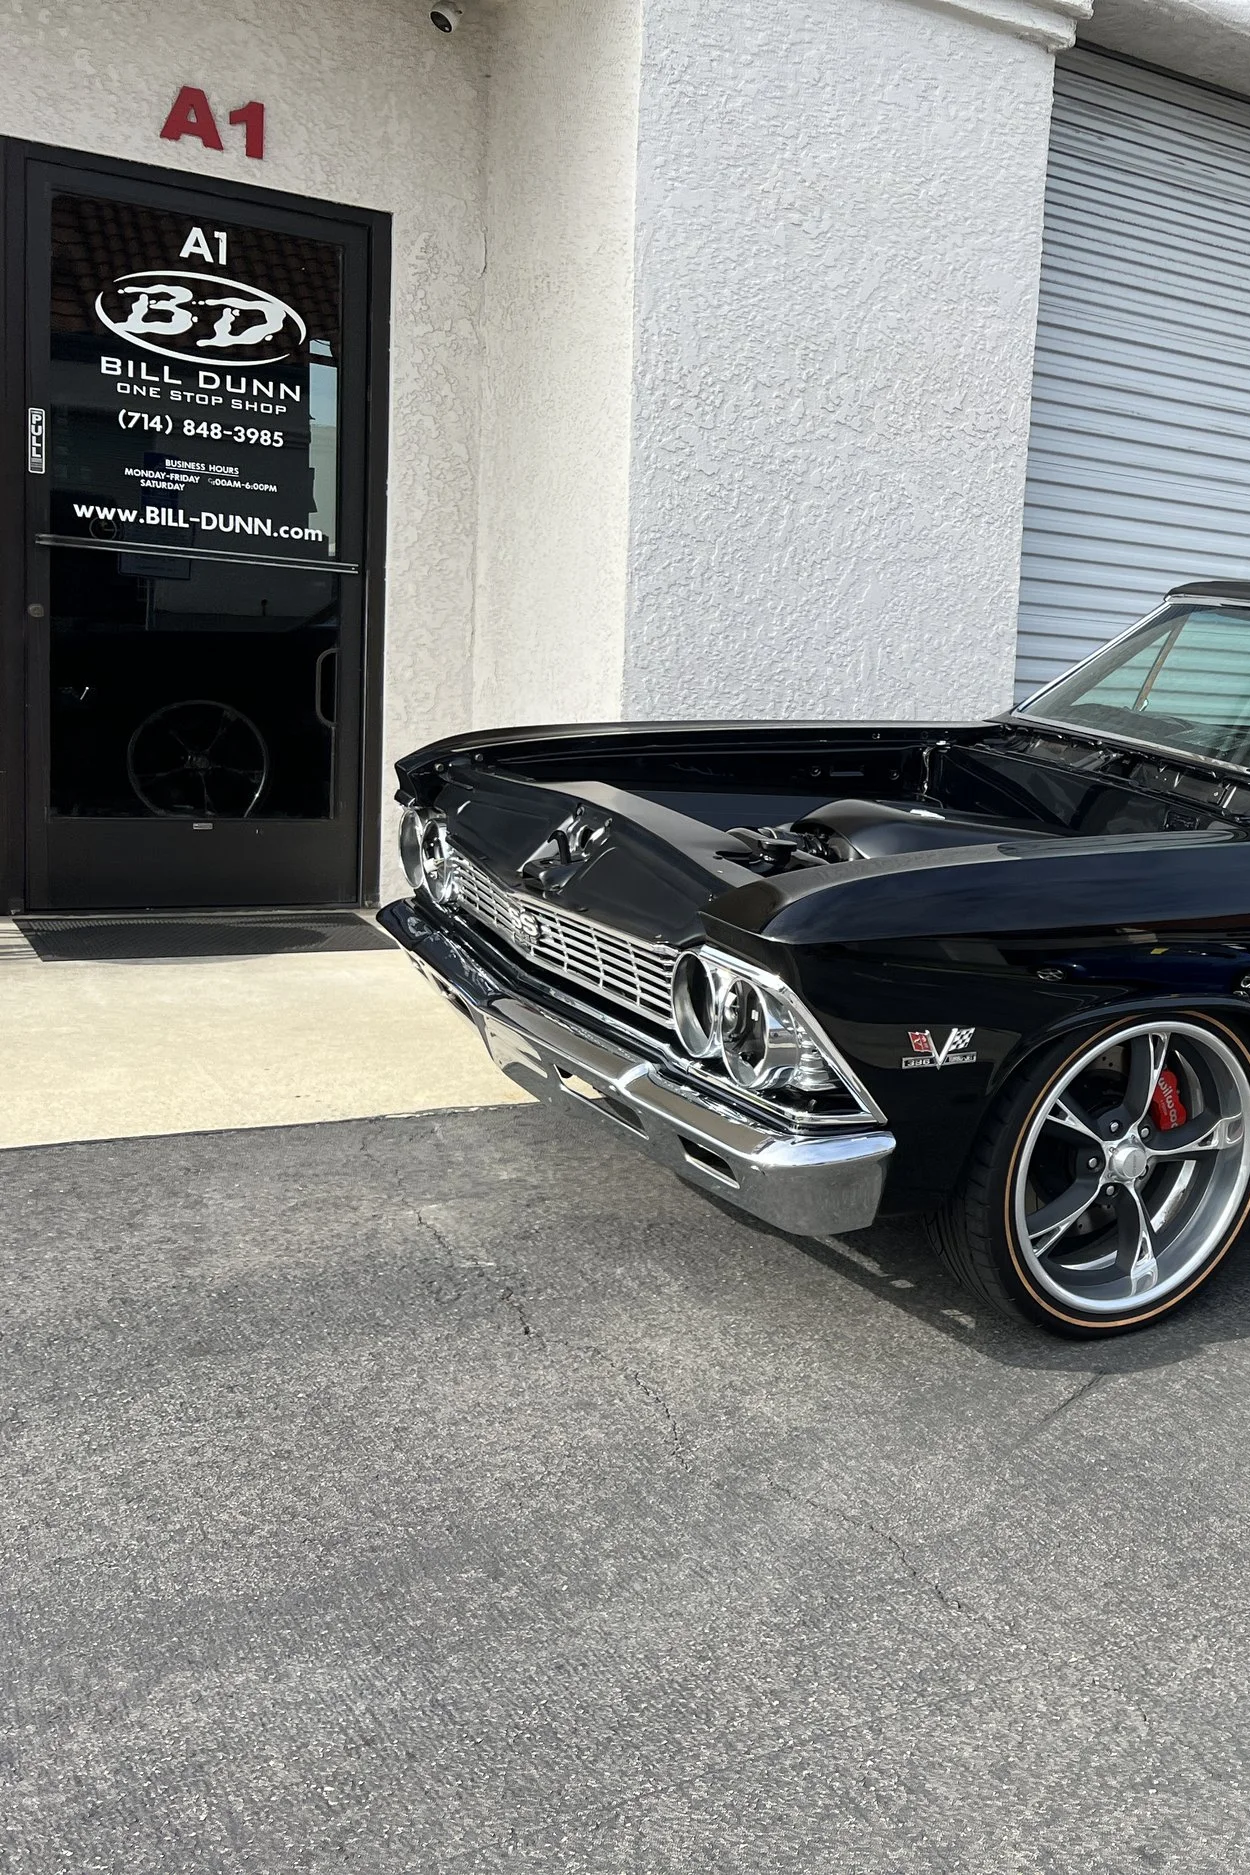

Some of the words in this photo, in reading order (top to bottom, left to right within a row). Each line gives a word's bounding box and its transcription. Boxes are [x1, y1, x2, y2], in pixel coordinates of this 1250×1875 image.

[160, 86, 264, 159] A1
[179, 227, 227, 265] A1
[101, 356, 182, 385] BILL
[198, 370, 301, 402] DUNN
[116, 382, 161, 398] ONE
[170, 390, 223, 406] STOP
[231, 398, 287, 415] SHOP
[31, 413, 43, 458] PULL
[118, 408, 173, 435] (714)
[183, 419, 284, 448] 848-3985
[124, 467, 201, 484] MONDAY-FRIDAY
[140, 478, 185, 491] SATURDAY
[165, 458, 206, 471] BUSINESS
[208, 463, 240, 475] HOURS
[73, 503, 323, 542] www.BILL-DUNN.com
[509, 907, 538, 936] SS
